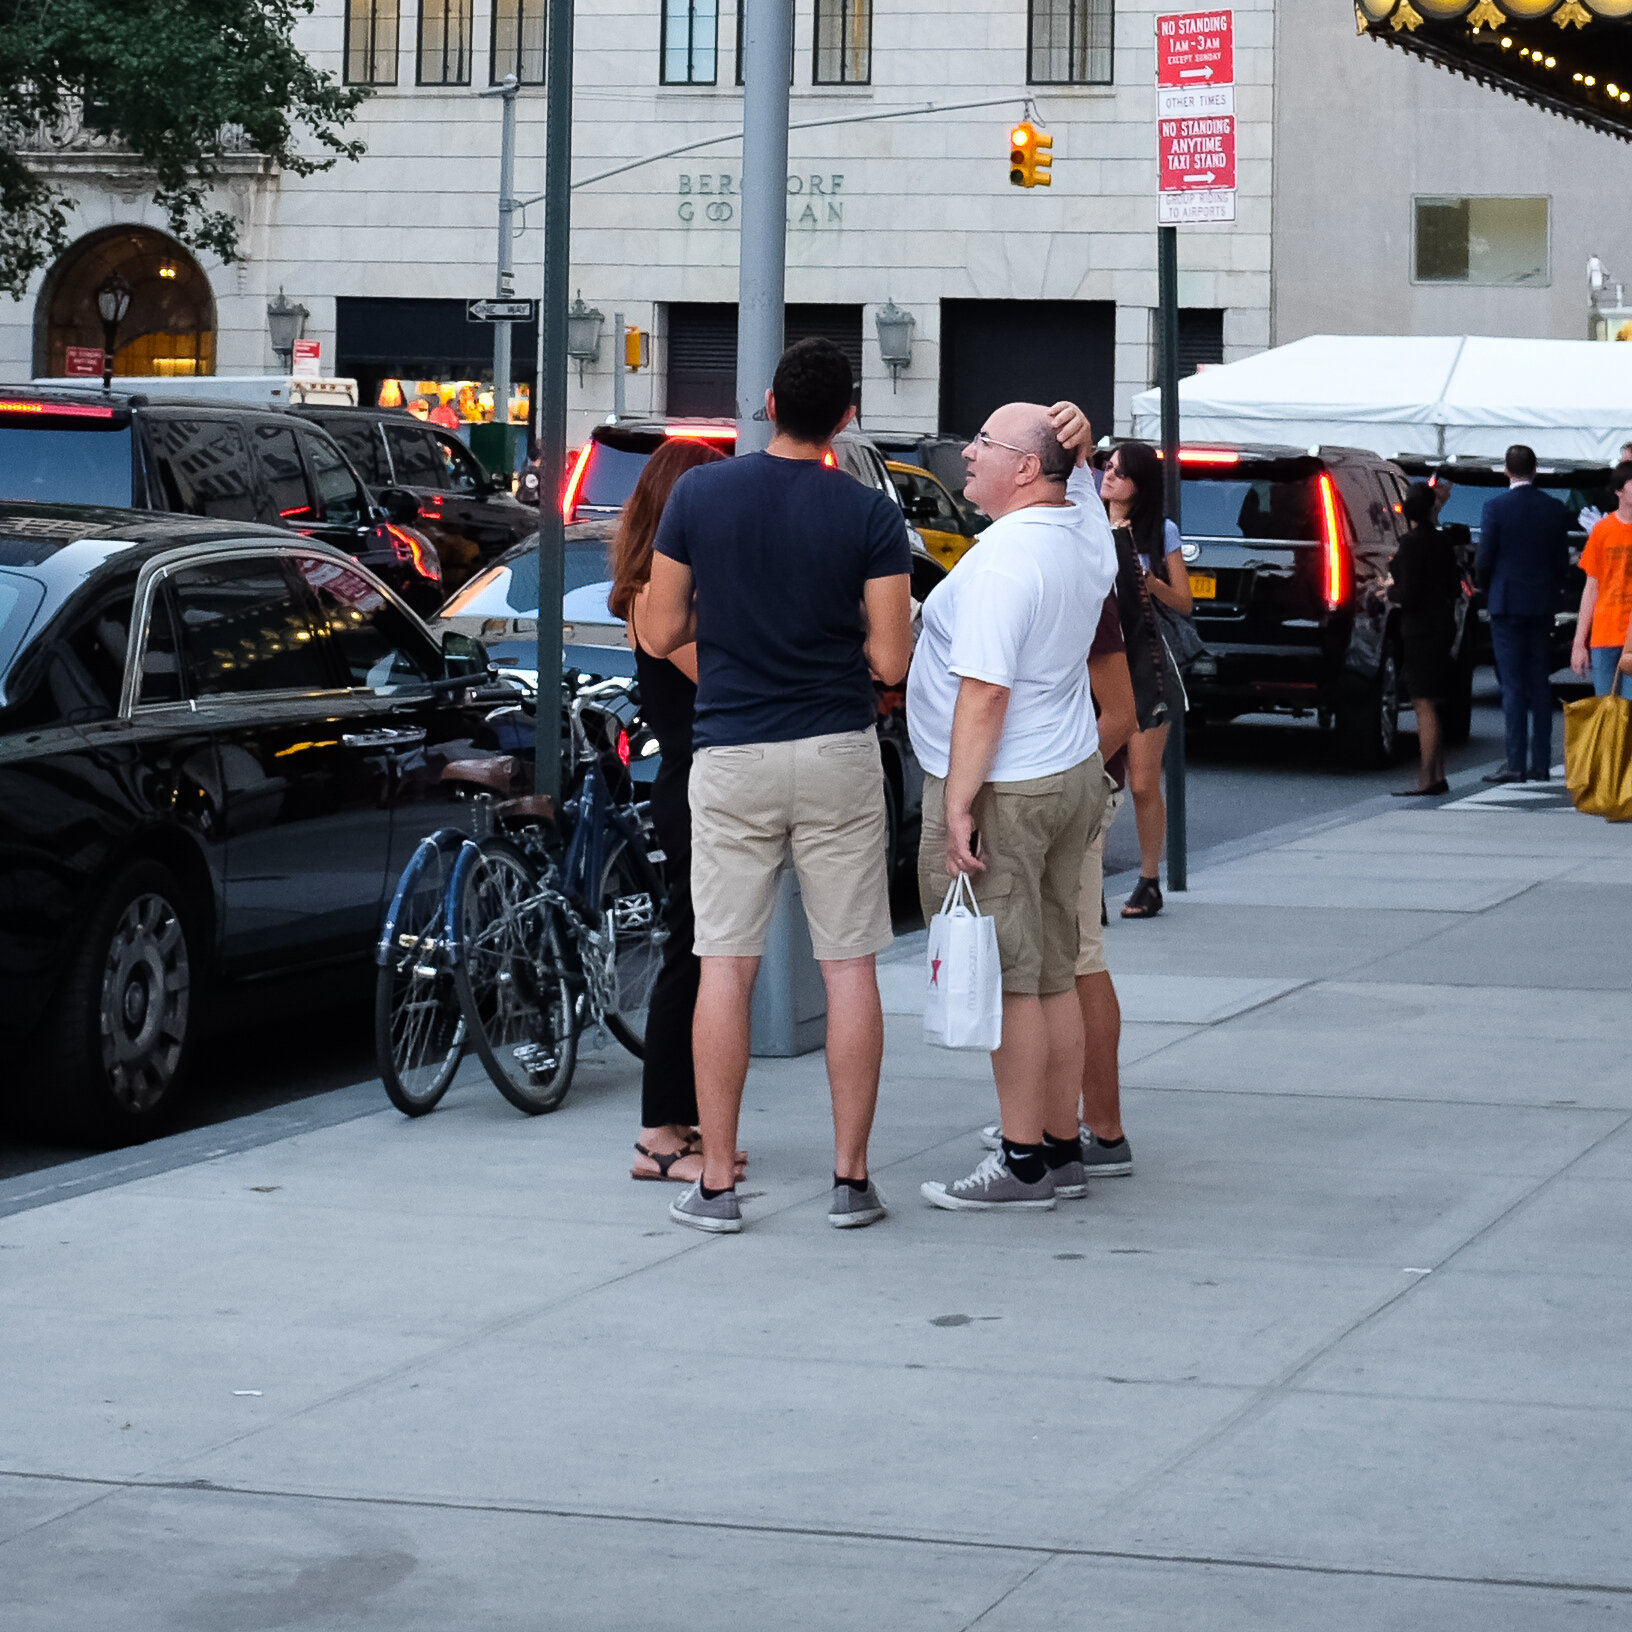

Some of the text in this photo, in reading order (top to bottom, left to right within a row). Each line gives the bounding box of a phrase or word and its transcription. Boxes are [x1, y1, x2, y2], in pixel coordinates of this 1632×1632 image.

[1161, 16, 1228, 36] NO STANDING
[1168, 54, 1192, 65] EXCEPT
[1166, 95, 1226, 109] OTHER TIMES
[1162, 119, 1230, 137] NO STANDING
[1171, 137, 1223, 153] ANYTIME
[1167, 153, 1226, 170] TAXI STAND
[678, 174, 845, 195] BERORF
[677, 201, 844, 222] GOOAN
[1182, 206, 1227, 218] AIRPORTS
